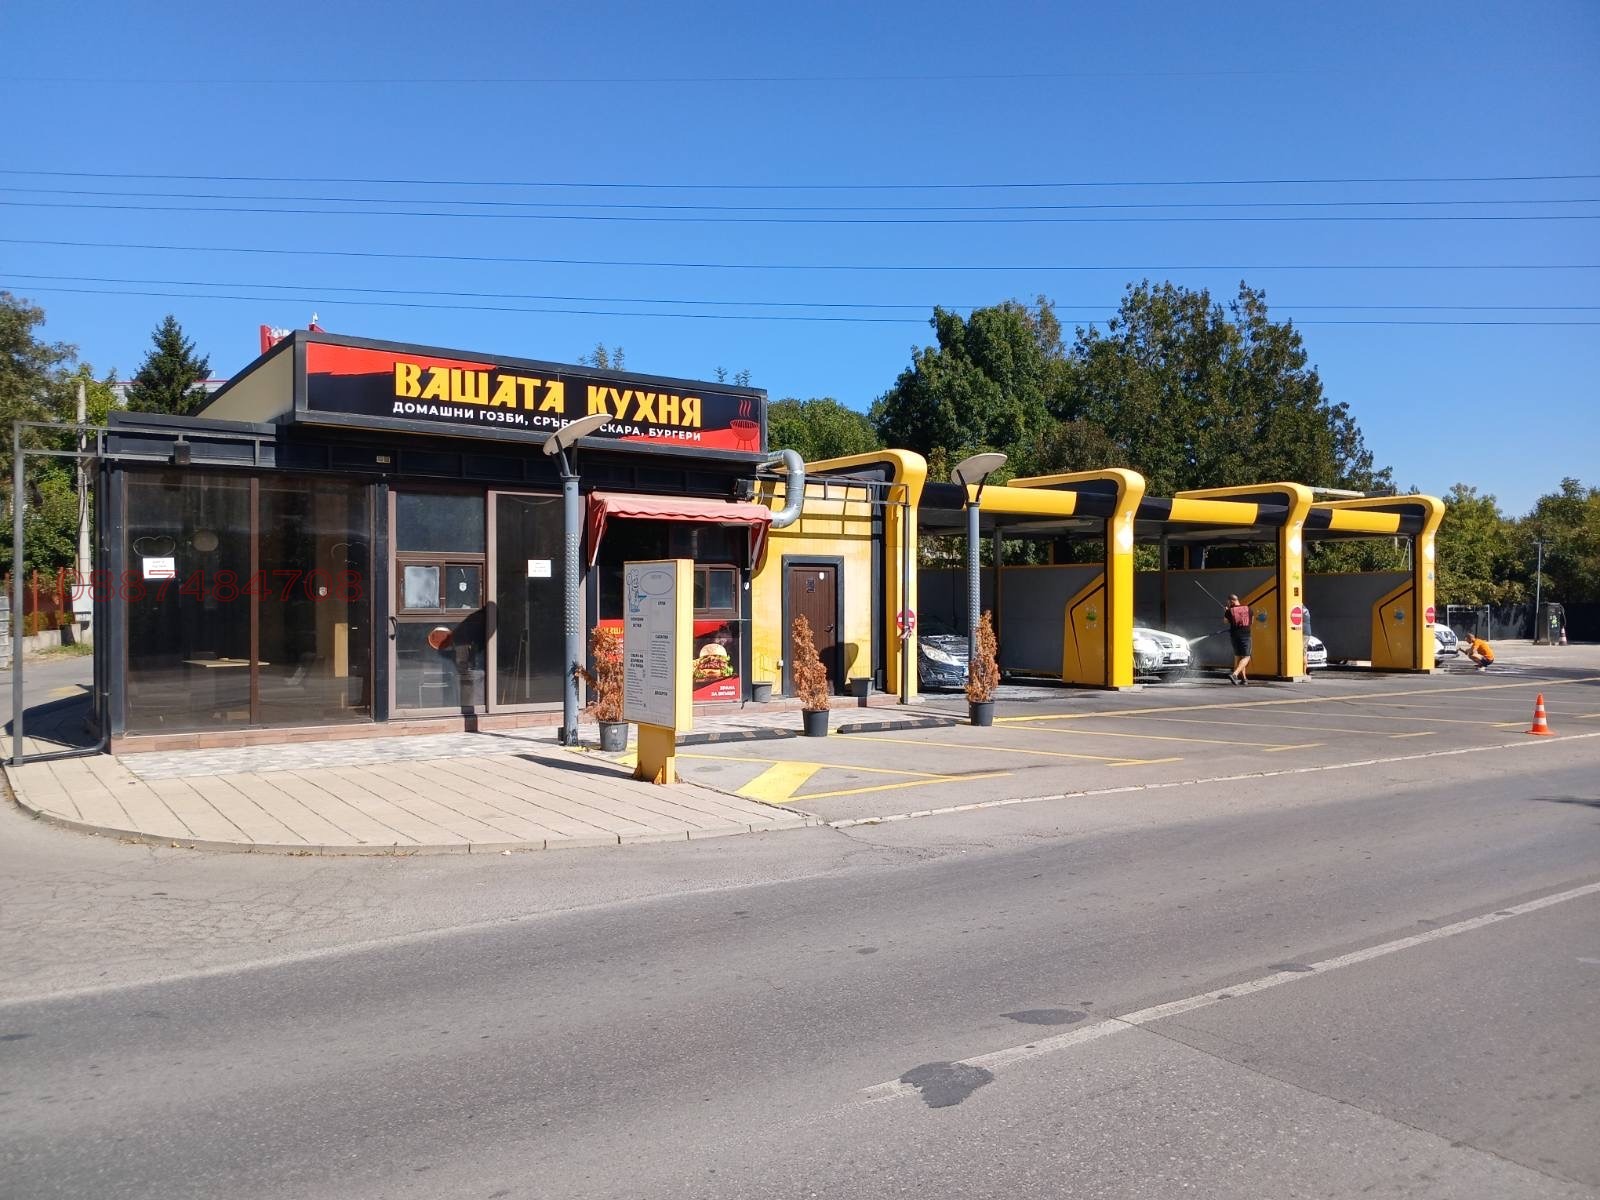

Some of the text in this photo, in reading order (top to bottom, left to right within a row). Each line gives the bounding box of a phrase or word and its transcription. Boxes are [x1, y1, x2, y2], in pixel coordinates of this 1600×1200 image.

[395, 362, 702, 428] ВАШАТА КУХНЯ
[393, 402, 474, 420] ДОМАШНИ
[479, 410, 529, 426] ГОЗБИ,
[599, 423, 645, 437] СКАРА,
[648, 427, 701, 442] БУРГЕРИ
